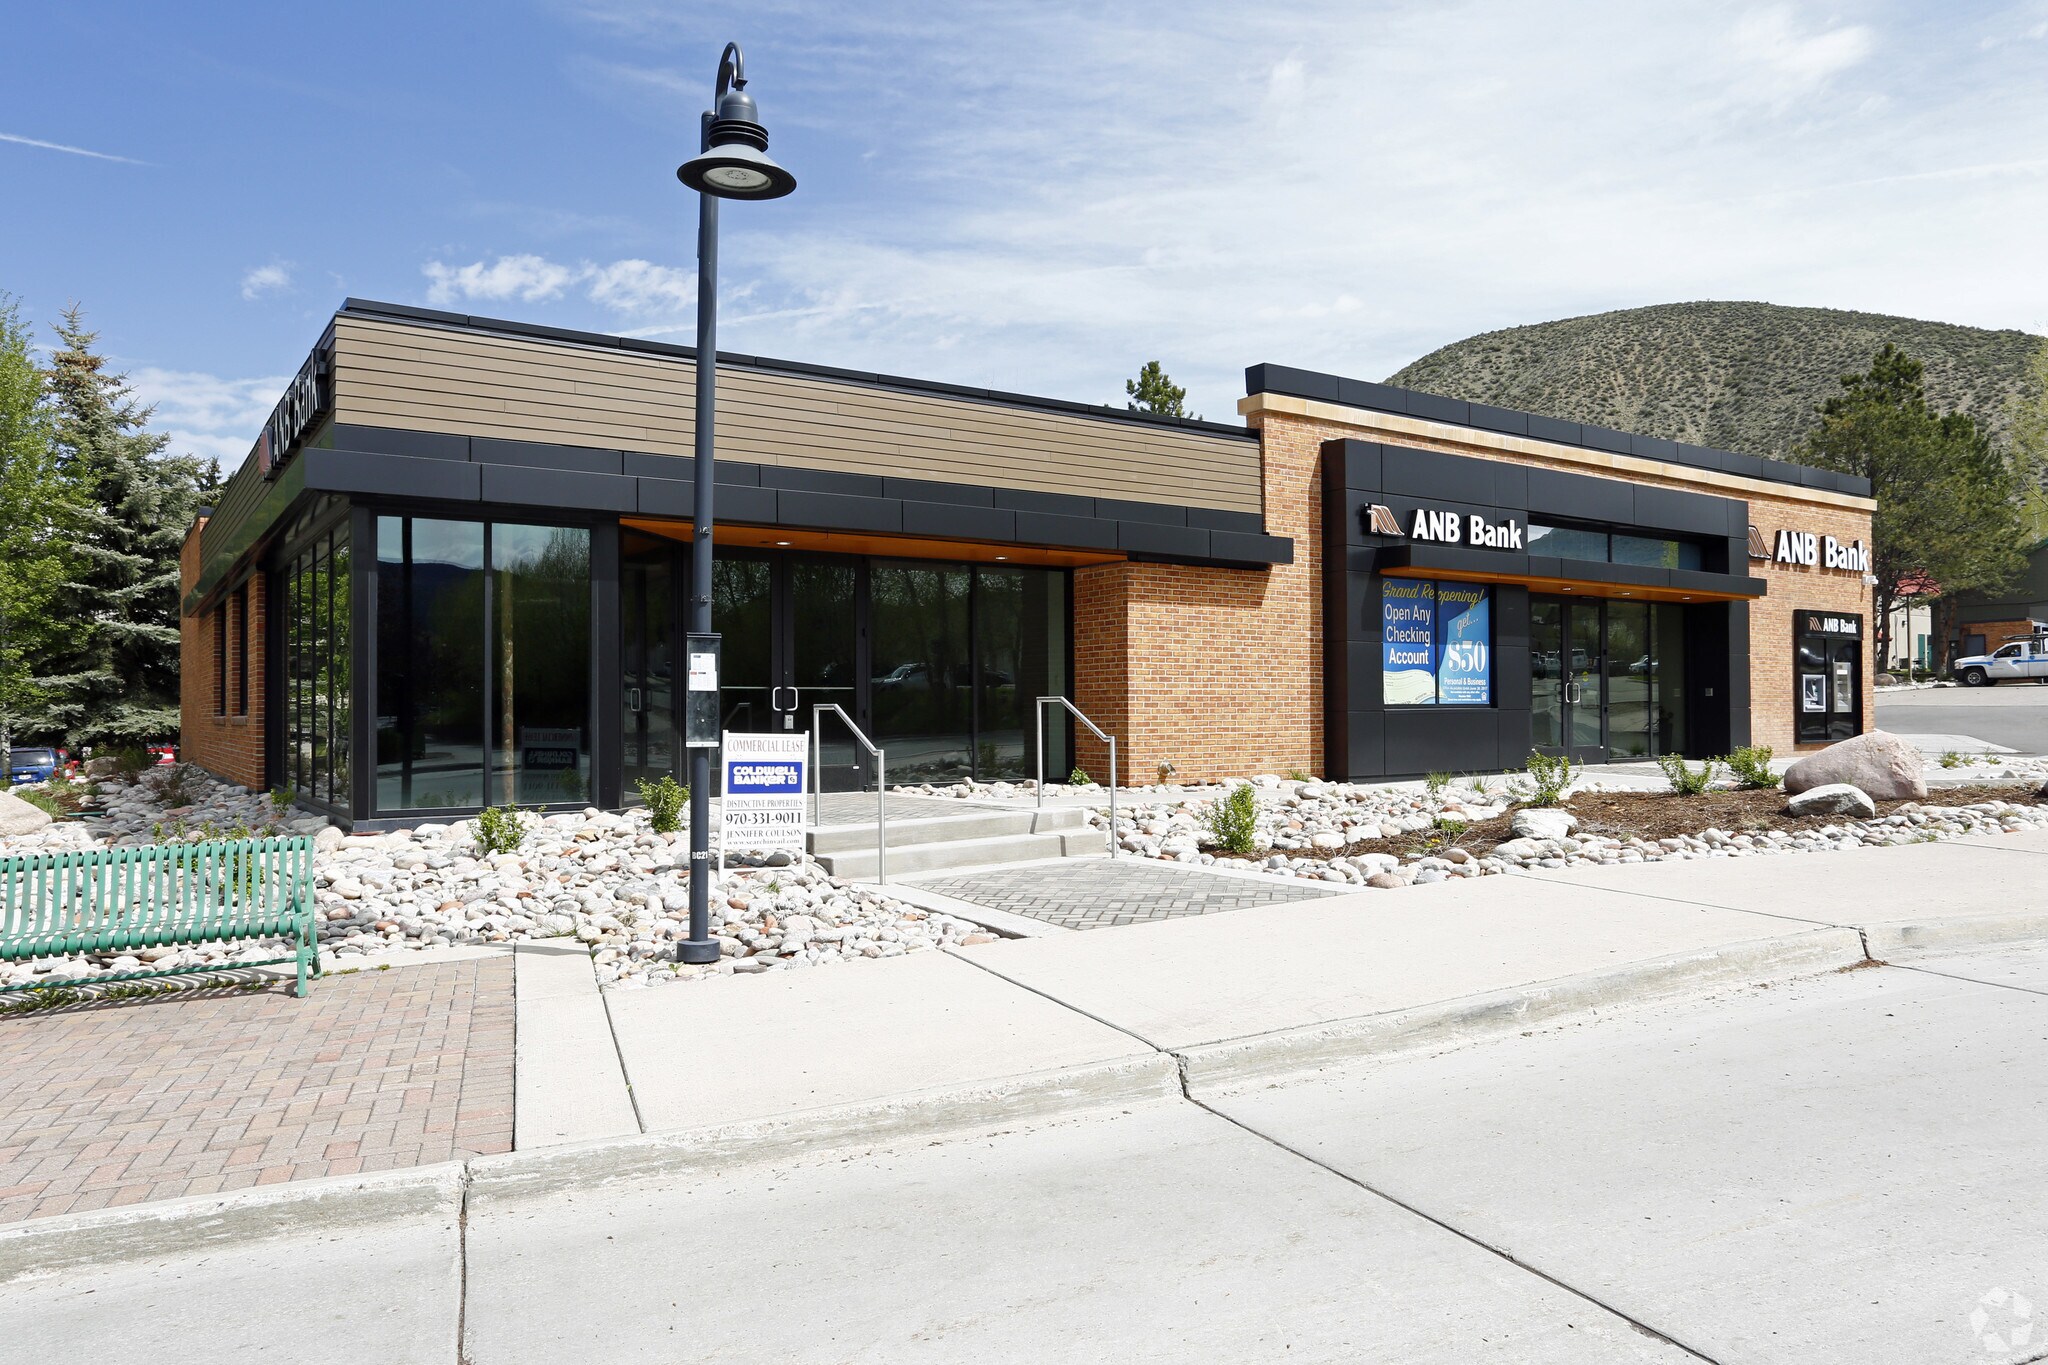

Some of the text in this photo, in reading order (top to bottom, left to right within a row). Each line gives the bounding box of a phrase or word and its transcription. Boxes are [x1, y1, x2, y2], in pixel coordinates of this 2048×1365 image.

[273, 350, 318, 467] ANB Bank
[1412, 508, 1523, 549] ANB Bank
[1776, 529, 1869, 572] ANB Bank
[1382, 581, 1420, 599] Grand
[1384, 603, 1431, 625] Open Any
[1823, 617, 1857, 634] ANB Bank
[1386, 625, 1431, 647] Checking
[1388, 647, 1429, 665] Account
[1448, 640, 1486, 673] $50
[1443, 677, 1463, 686] Personal
[1467, 677, 1487, 686] Business
[728, 739, 805, 753] COMMERCIAL LEASE
[733, 766, 798, 776] COLDWELL
[734, 775, 786, 786] BANKER
[727, 799, 803, 808] DISTINCTIVE PROPERTIES
[725, 812, 802, 826] 970-331-9011
[727, 829, 802, 839] JENNIFER COULSON
[691, 850, 708, 860] BC21
